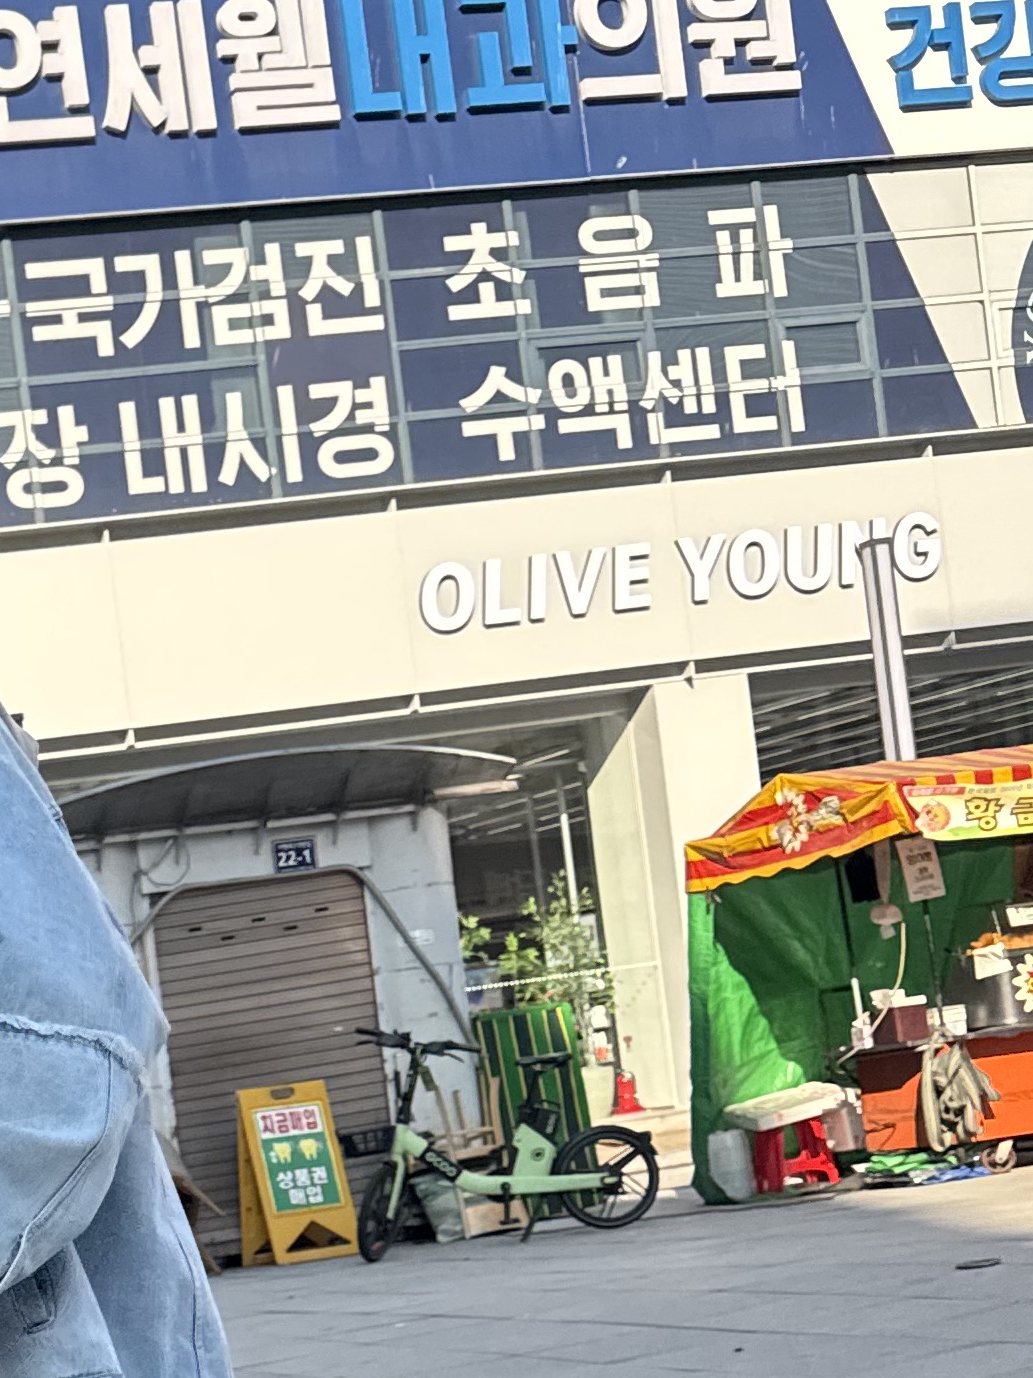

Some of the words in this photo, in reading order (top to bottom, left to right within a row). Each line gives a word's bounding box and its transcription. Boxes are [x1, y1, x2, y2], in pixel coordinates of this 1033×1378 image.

[119, 375, 396, 496] 내시경
[459, 340, 806, 462] 수액센터
[419, 540, 652, 635] OLIVE
[277, 848, 312, 867] 22-1
[276, 1165, 329, 1190] 상품권
